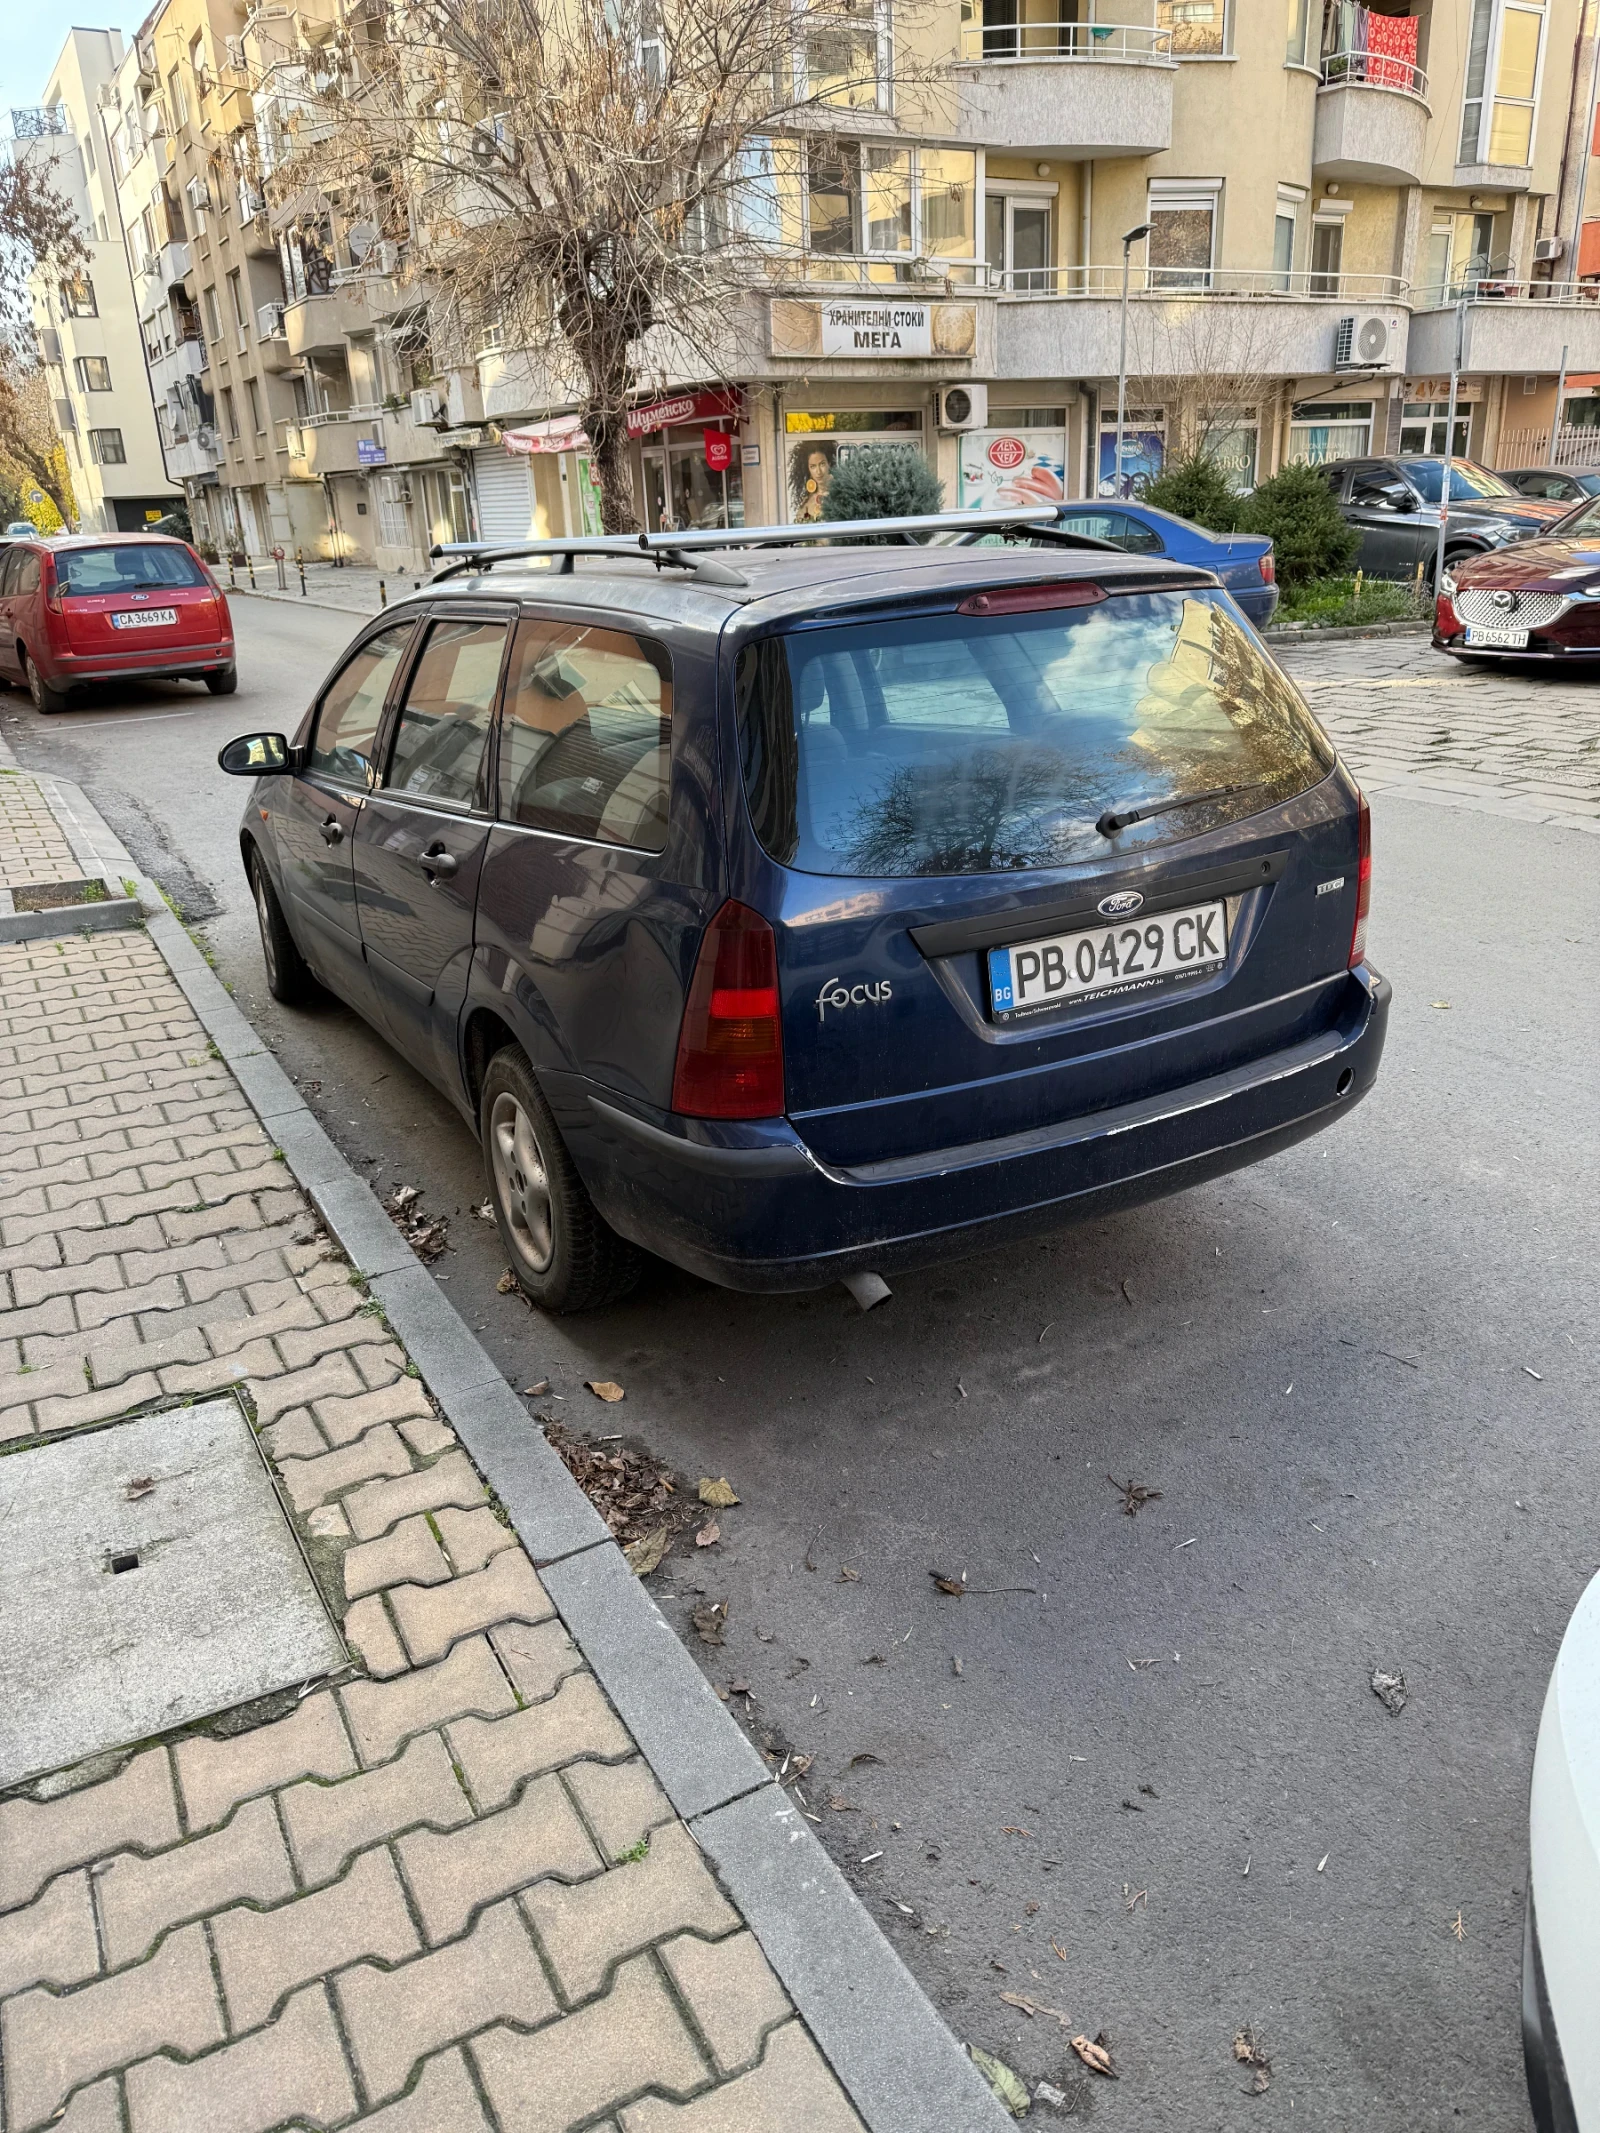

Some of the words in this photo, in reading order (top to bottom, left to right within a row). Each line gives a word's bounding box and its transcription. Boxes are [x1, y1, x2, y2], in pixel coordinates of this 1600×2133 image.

[829, 309, 891, 327] ХРАНИТЕЛНИ
[893, 310, 925, 328] СТОКИ
[853, 331, 902, 349] МЕГА
[627, 399, 696, 433] Шуменско
[120, 615, 133, 625] CA
[135, 612, 159, 624] 3669
[161, 610, 175, 621] KA
[1108, 896, 1138, 912] Ford
[1015, 945, 1068, 999] PB
[1075, 923, 1165, 983] 0429
[1172, 910, 1220, 962] CK
[995, 986, 1012, 1003] BG
